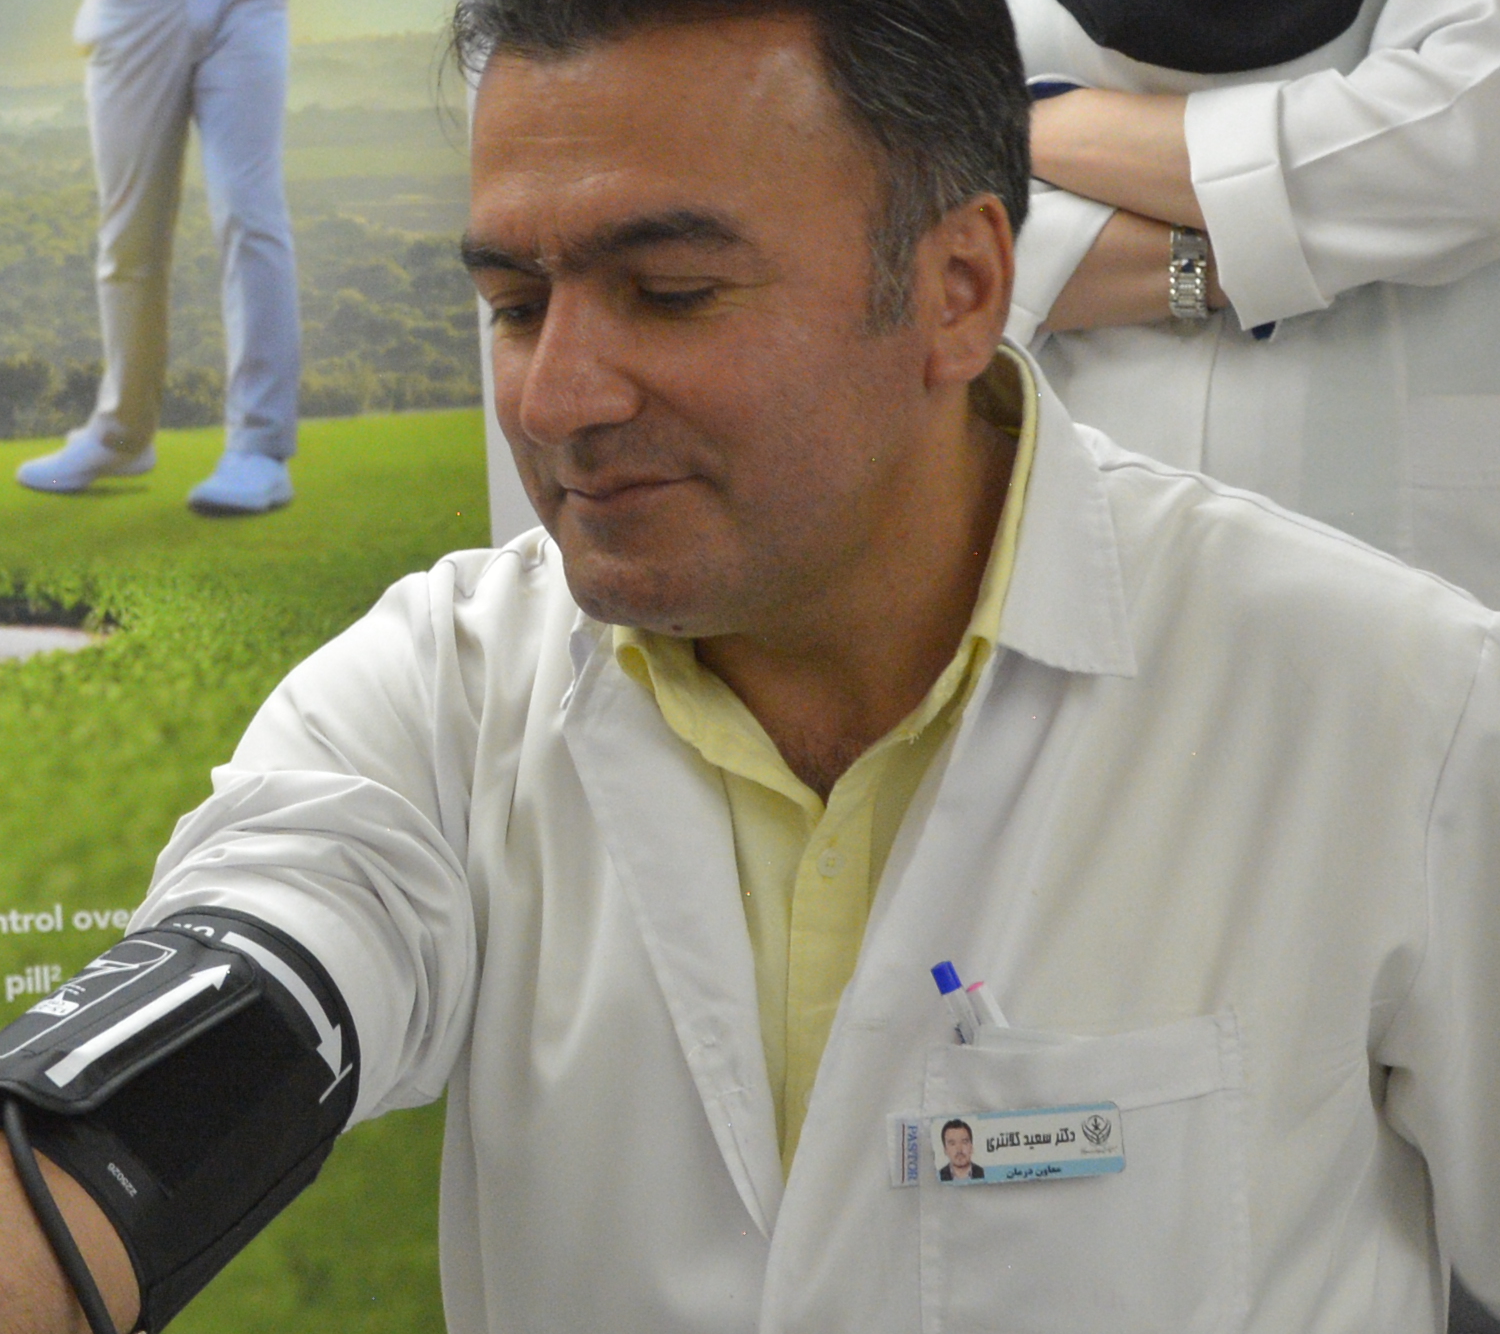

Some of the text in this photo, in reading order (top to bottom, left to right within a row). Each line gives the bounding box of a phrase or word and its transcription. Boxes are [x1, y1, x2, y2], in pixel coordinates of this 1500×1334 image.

[72, 907, 134, 931] ove
[907, 1124, 919, 1182] PASTOR
[985, 1127, 1076, 1153] دکتر سعید کلانتری
